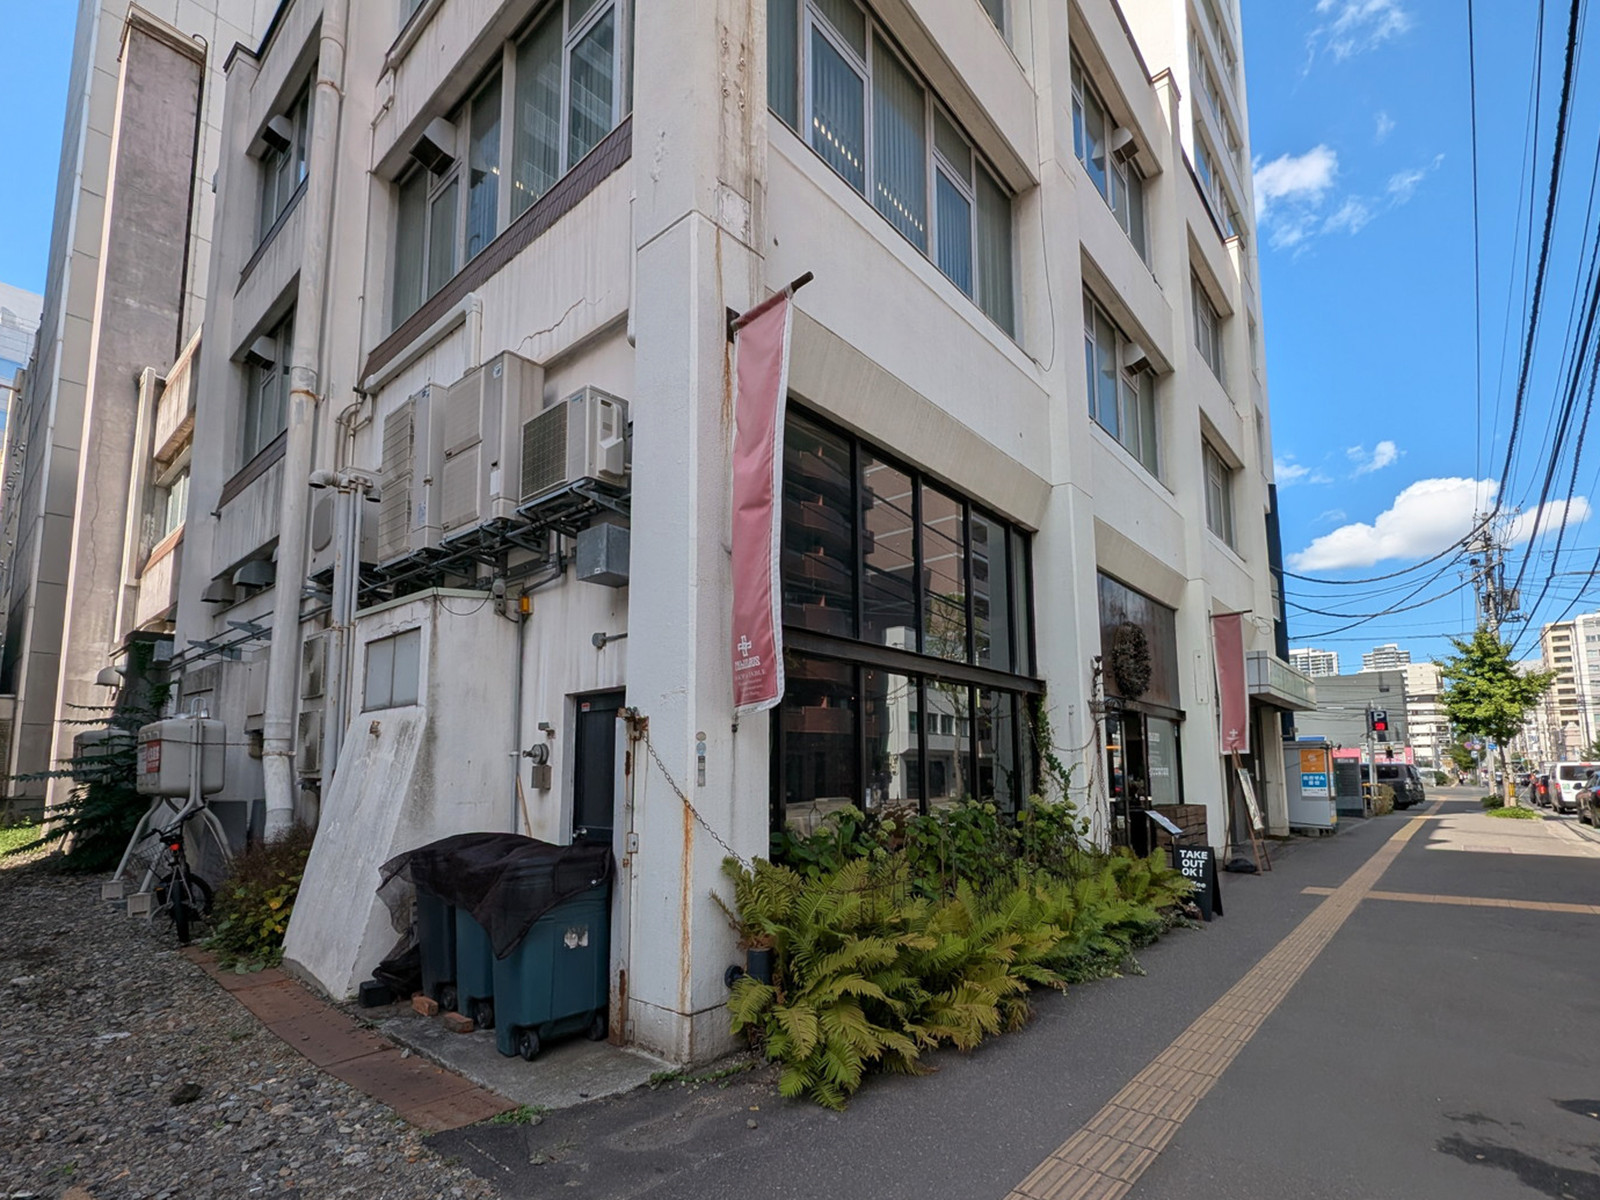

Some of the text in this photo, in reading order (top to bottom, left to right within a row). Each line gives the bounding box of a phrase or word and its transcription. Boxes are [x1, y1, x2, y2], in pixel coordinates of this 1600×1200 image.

[1373, 711, 1385, 722] P
[1179, 850, 1208, 860] TAKE
[1182, 859, 1205, 868] OUT
